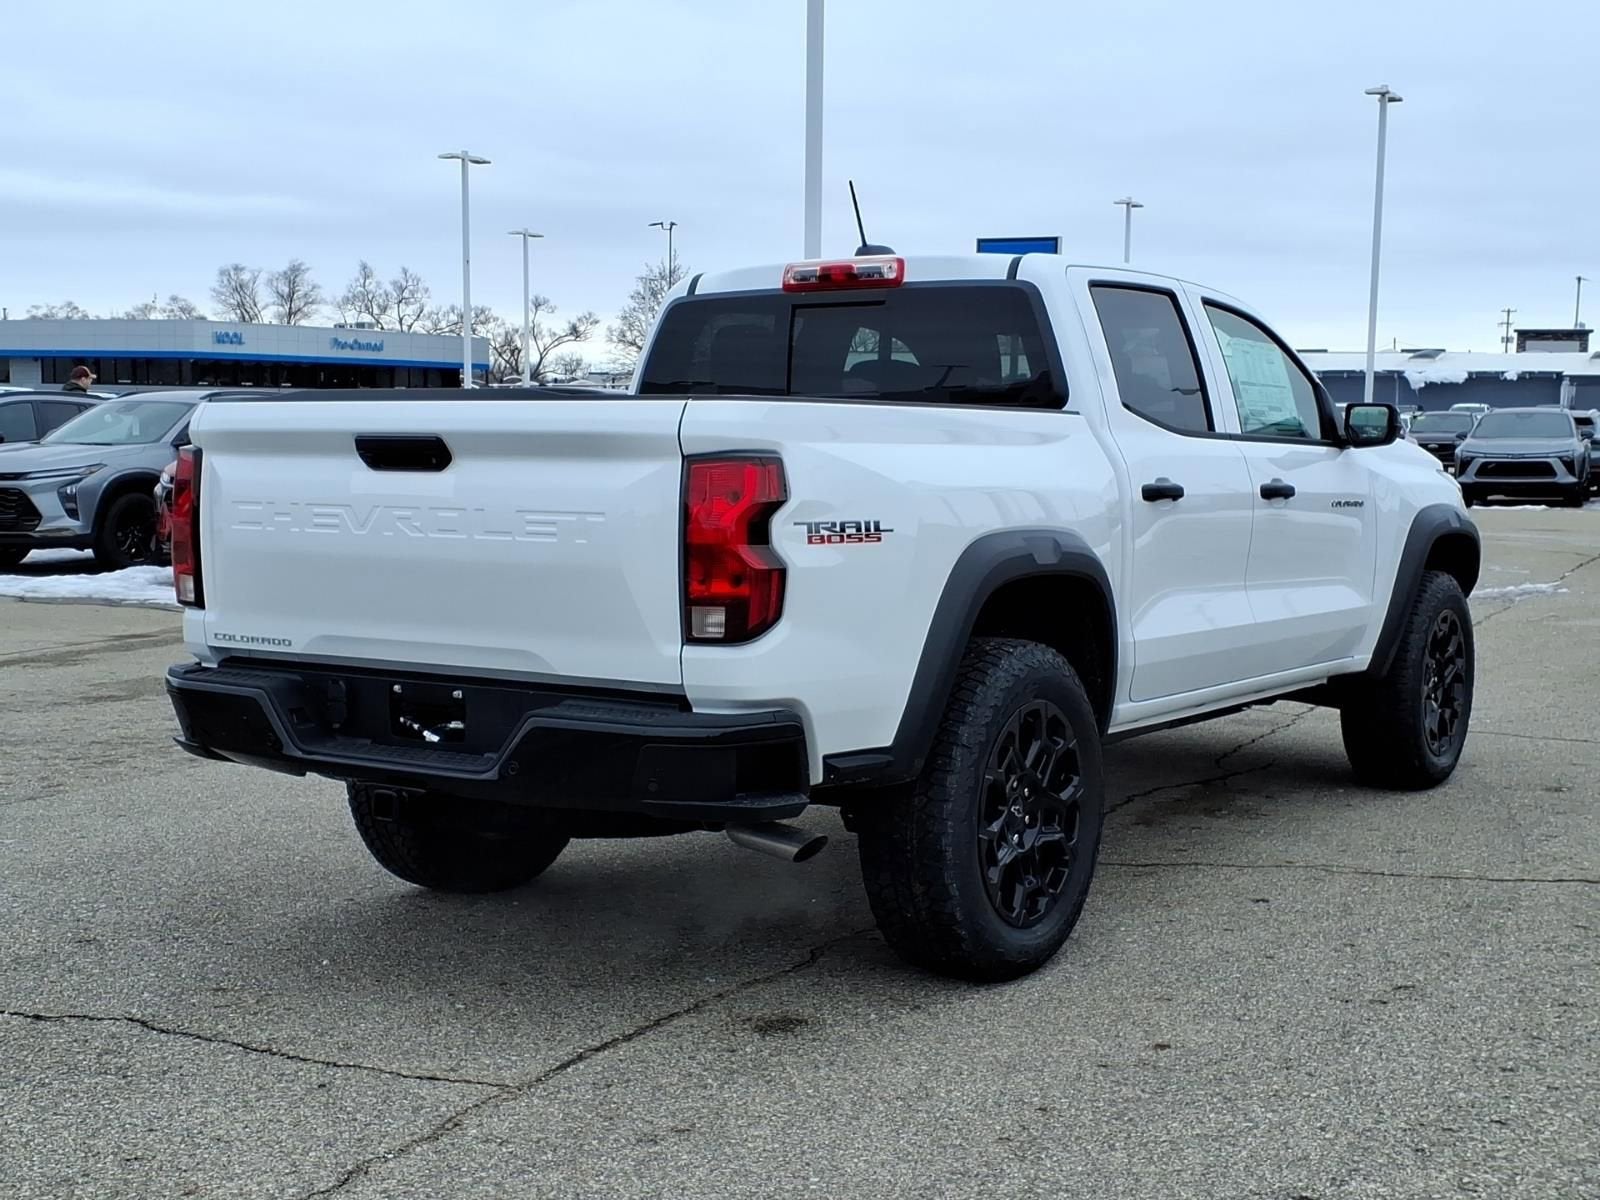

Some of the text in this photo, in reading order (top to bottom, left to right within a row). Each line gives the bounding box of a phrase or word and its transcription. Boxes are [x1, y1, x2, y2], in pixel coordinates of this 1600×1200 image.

[231, 500, 606, 544] CHEVROLET
[793, 520, 894, 534] TRAIL
[807, 533, 882, 545] BOSS
[214, 632, 292, 647] COLORADO
